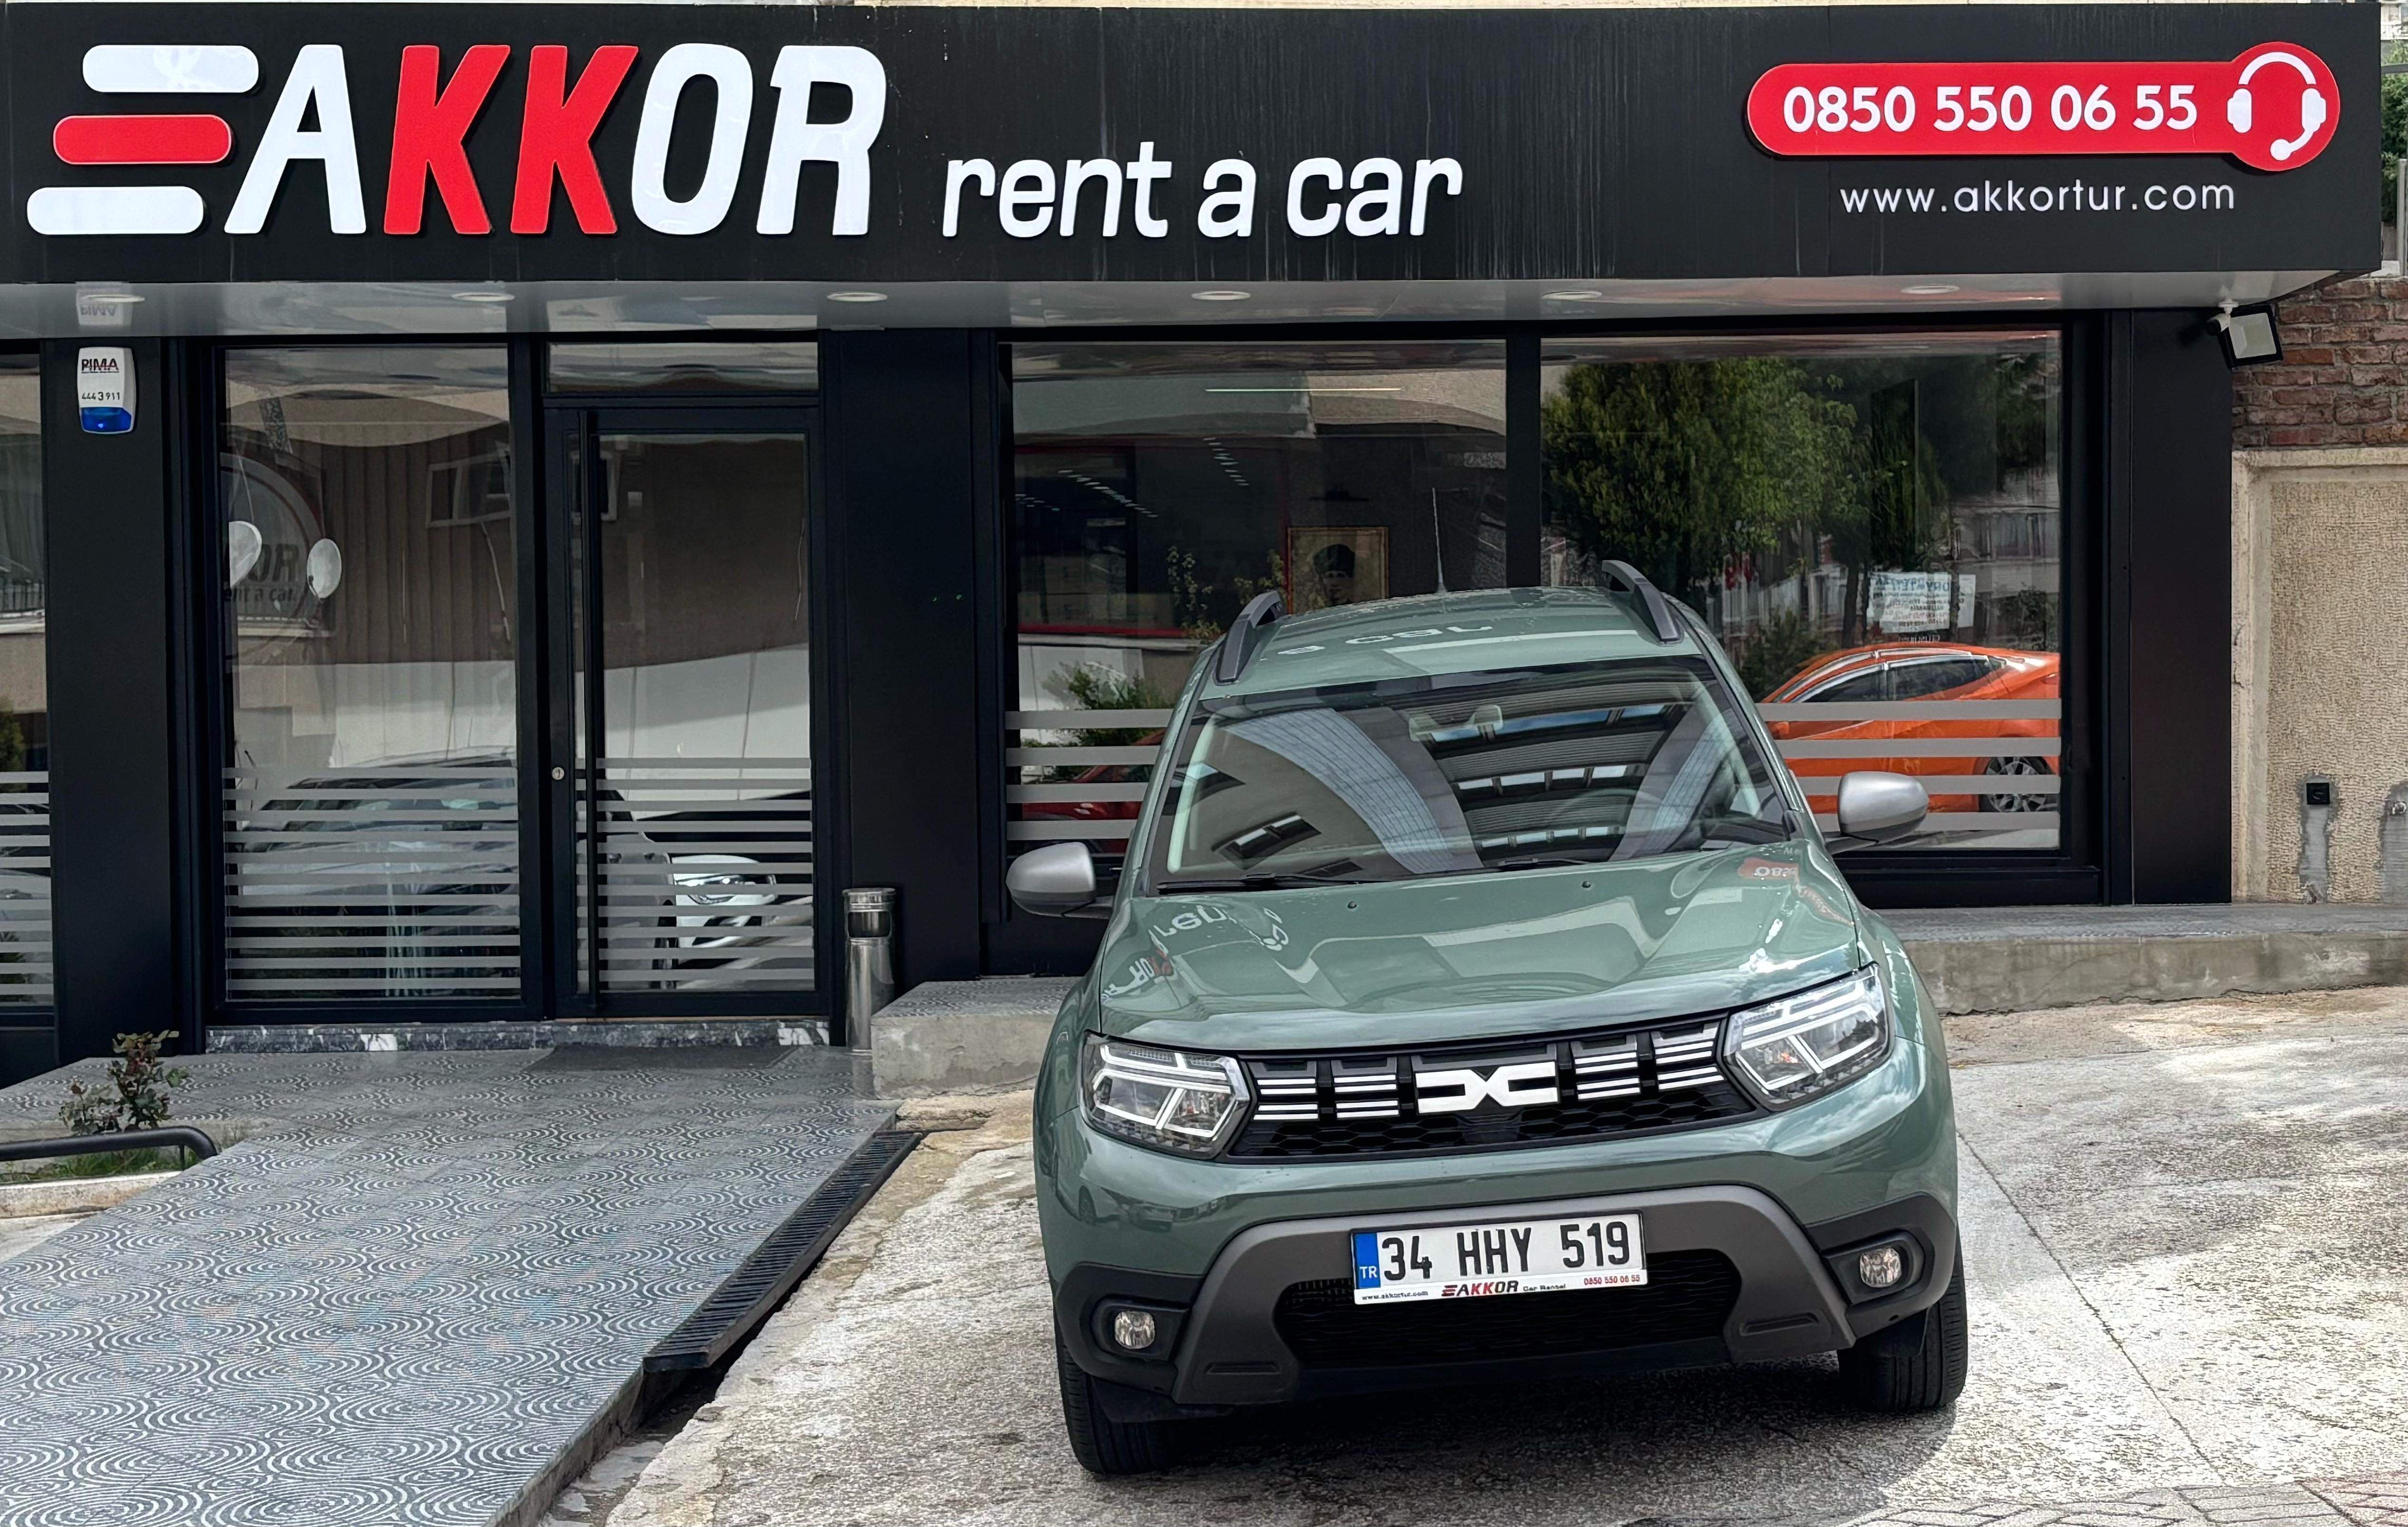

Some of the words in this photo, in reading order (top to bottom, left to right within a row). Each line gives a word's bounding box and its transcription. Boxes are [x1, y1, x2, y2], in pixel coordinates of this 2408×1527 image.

[1784, 86, 1916, 133] 0850
[1933, 85, 2032, 132] 550
[2051, 84, 2116, 131] 06
[2133, 85, 2198, 130] 55
[224, 43, 887, 236] AKKOR
[942, 141, 1173, 238] rent
[1197, 158, 1256, 238] a
[1286, 157, 1463, 238] car
[1840, 179, 2234, 213] www.akkortur.com
[82, 358, 119, 371] PIMA
[1382, 1236, 1433, 1281] 34
[1456, 1227, 1531, 1277] HHY
[1559, 1221, 1630, 1268] 519
[1359, 1266, 1377, 1278] TR
[1456, 1280, 1519, 1297] AKKOR
[1584, 1277, 1602, 1286] 0850
[1604, 1276, 1618, 1284] 550
